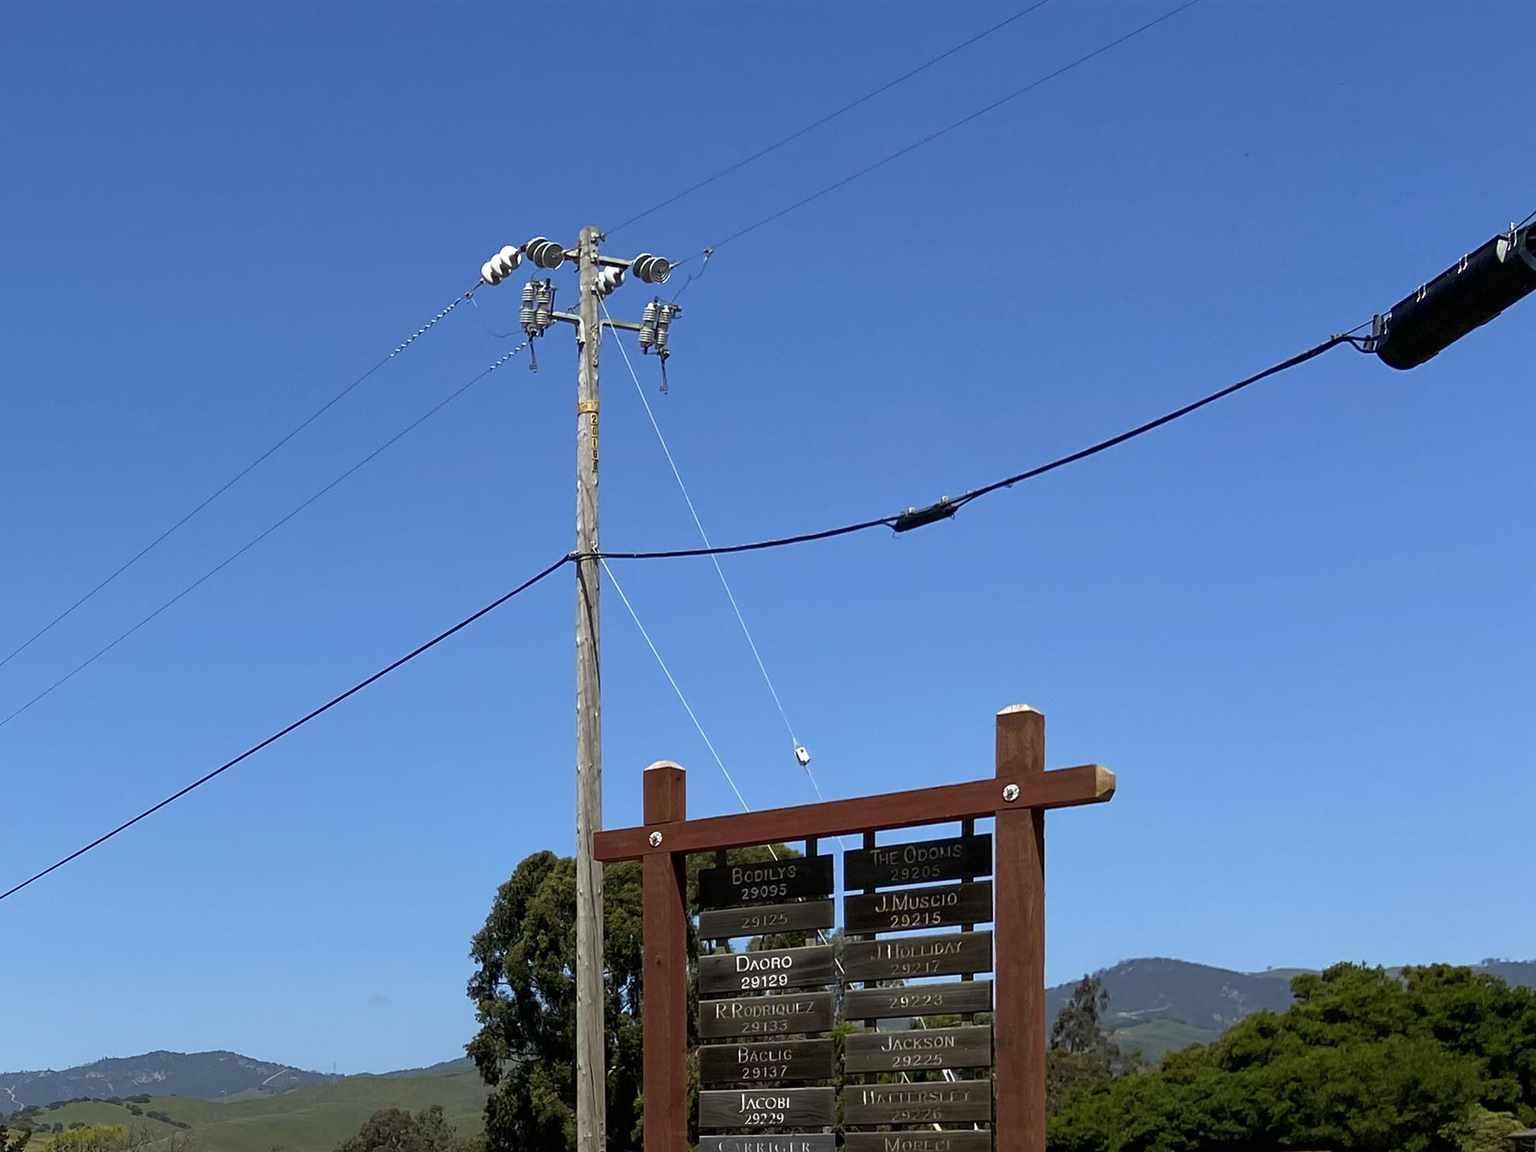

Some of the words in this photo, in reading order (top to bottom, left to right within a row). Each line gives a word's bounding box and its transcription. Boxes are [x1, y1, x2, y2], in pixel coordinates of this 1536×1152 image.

[870, 849, 898, 867] THE
[732, 865, 797, 885] BODILYS
[891, 865, 941, 881] 29205
[742, 883, 788, 899] 29095
[742, 913, 788, 928] 29125
[890, 911, 942, 929] 29215
[736, 955, 792, 972] DAORO
[891, 959, 941, 975] 29217
[741, 974, 788, 989] 29129
[889, 994, 943, 1009] 29223
[881, 1035, 955, 1052] JACKSON
[738, 1046, 792, 1063] BACLIG
[892, 1053, 943, 1067] 29225
[742, 1065, 788, 1079] 29137
[739, 1093, 790, 1113] JACOBI
[744, 1112, 784, 1125] 29229
